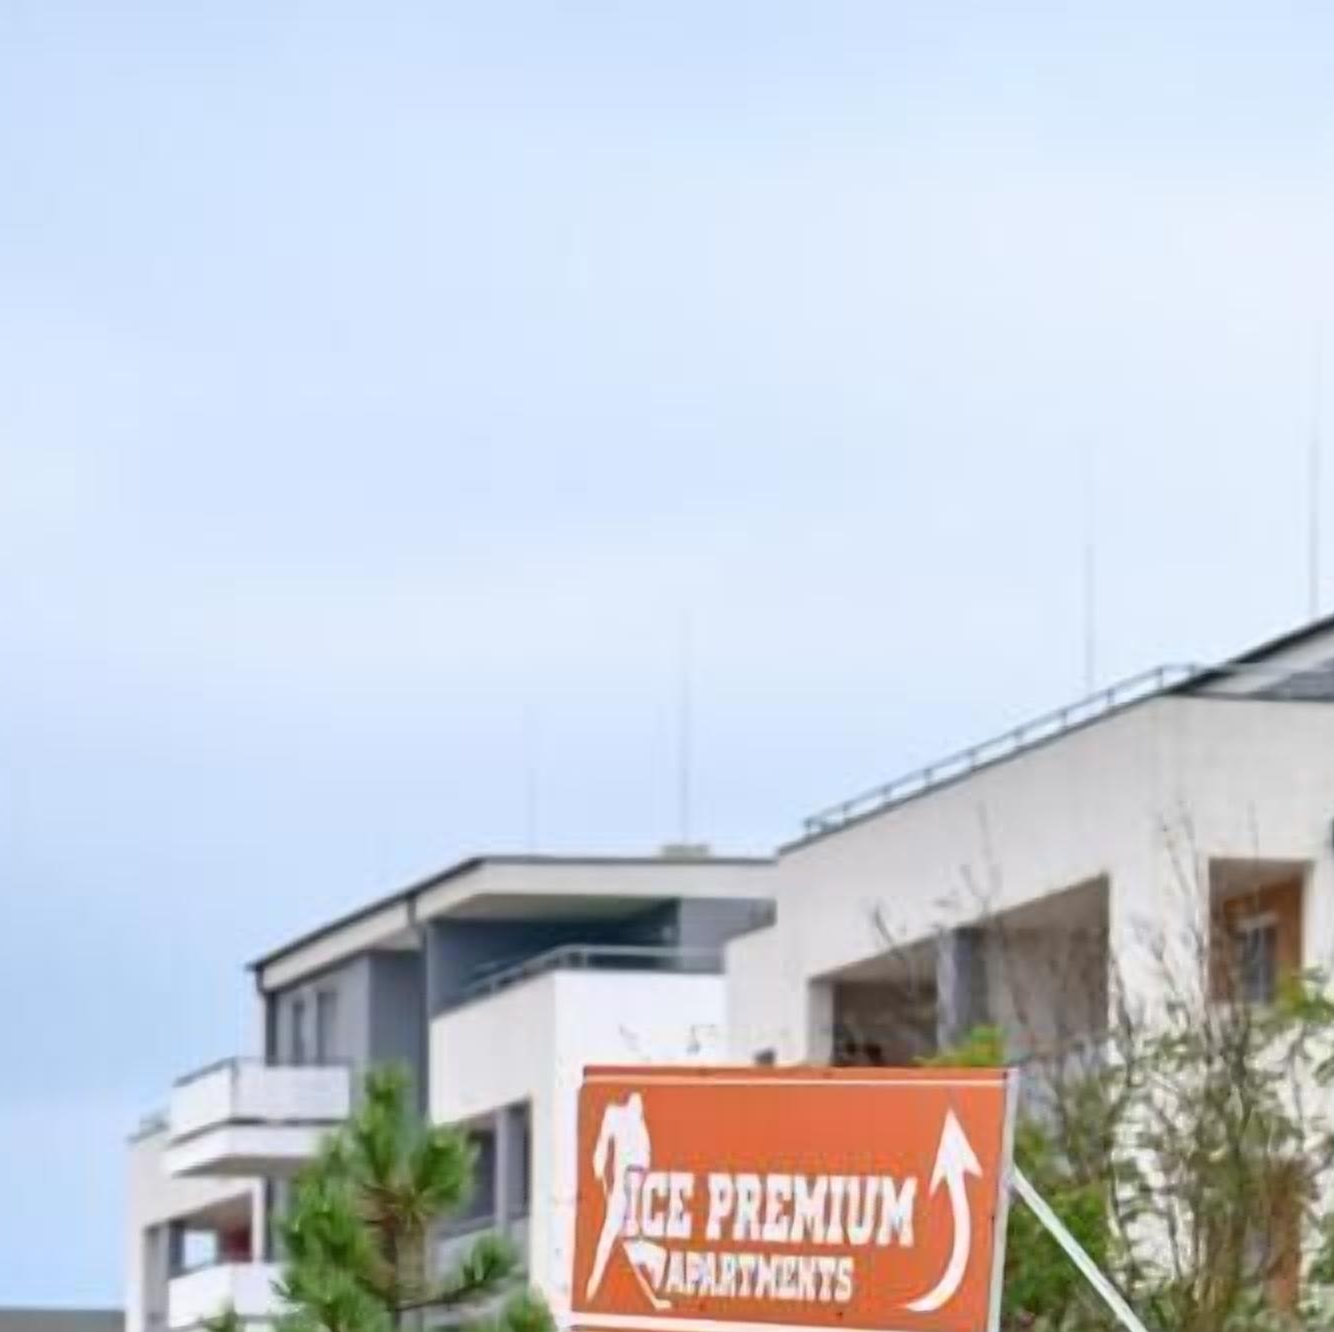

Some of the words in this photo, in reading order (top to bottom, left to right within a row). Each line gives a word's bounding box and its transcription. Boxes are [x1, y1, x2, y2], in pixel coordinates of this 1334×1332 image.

[622, 1166, 696, 1240] ICE
[705, 1171, 918, 1248] PREMIUM
[663, 1250, 855, 1302] APARTMENTS
